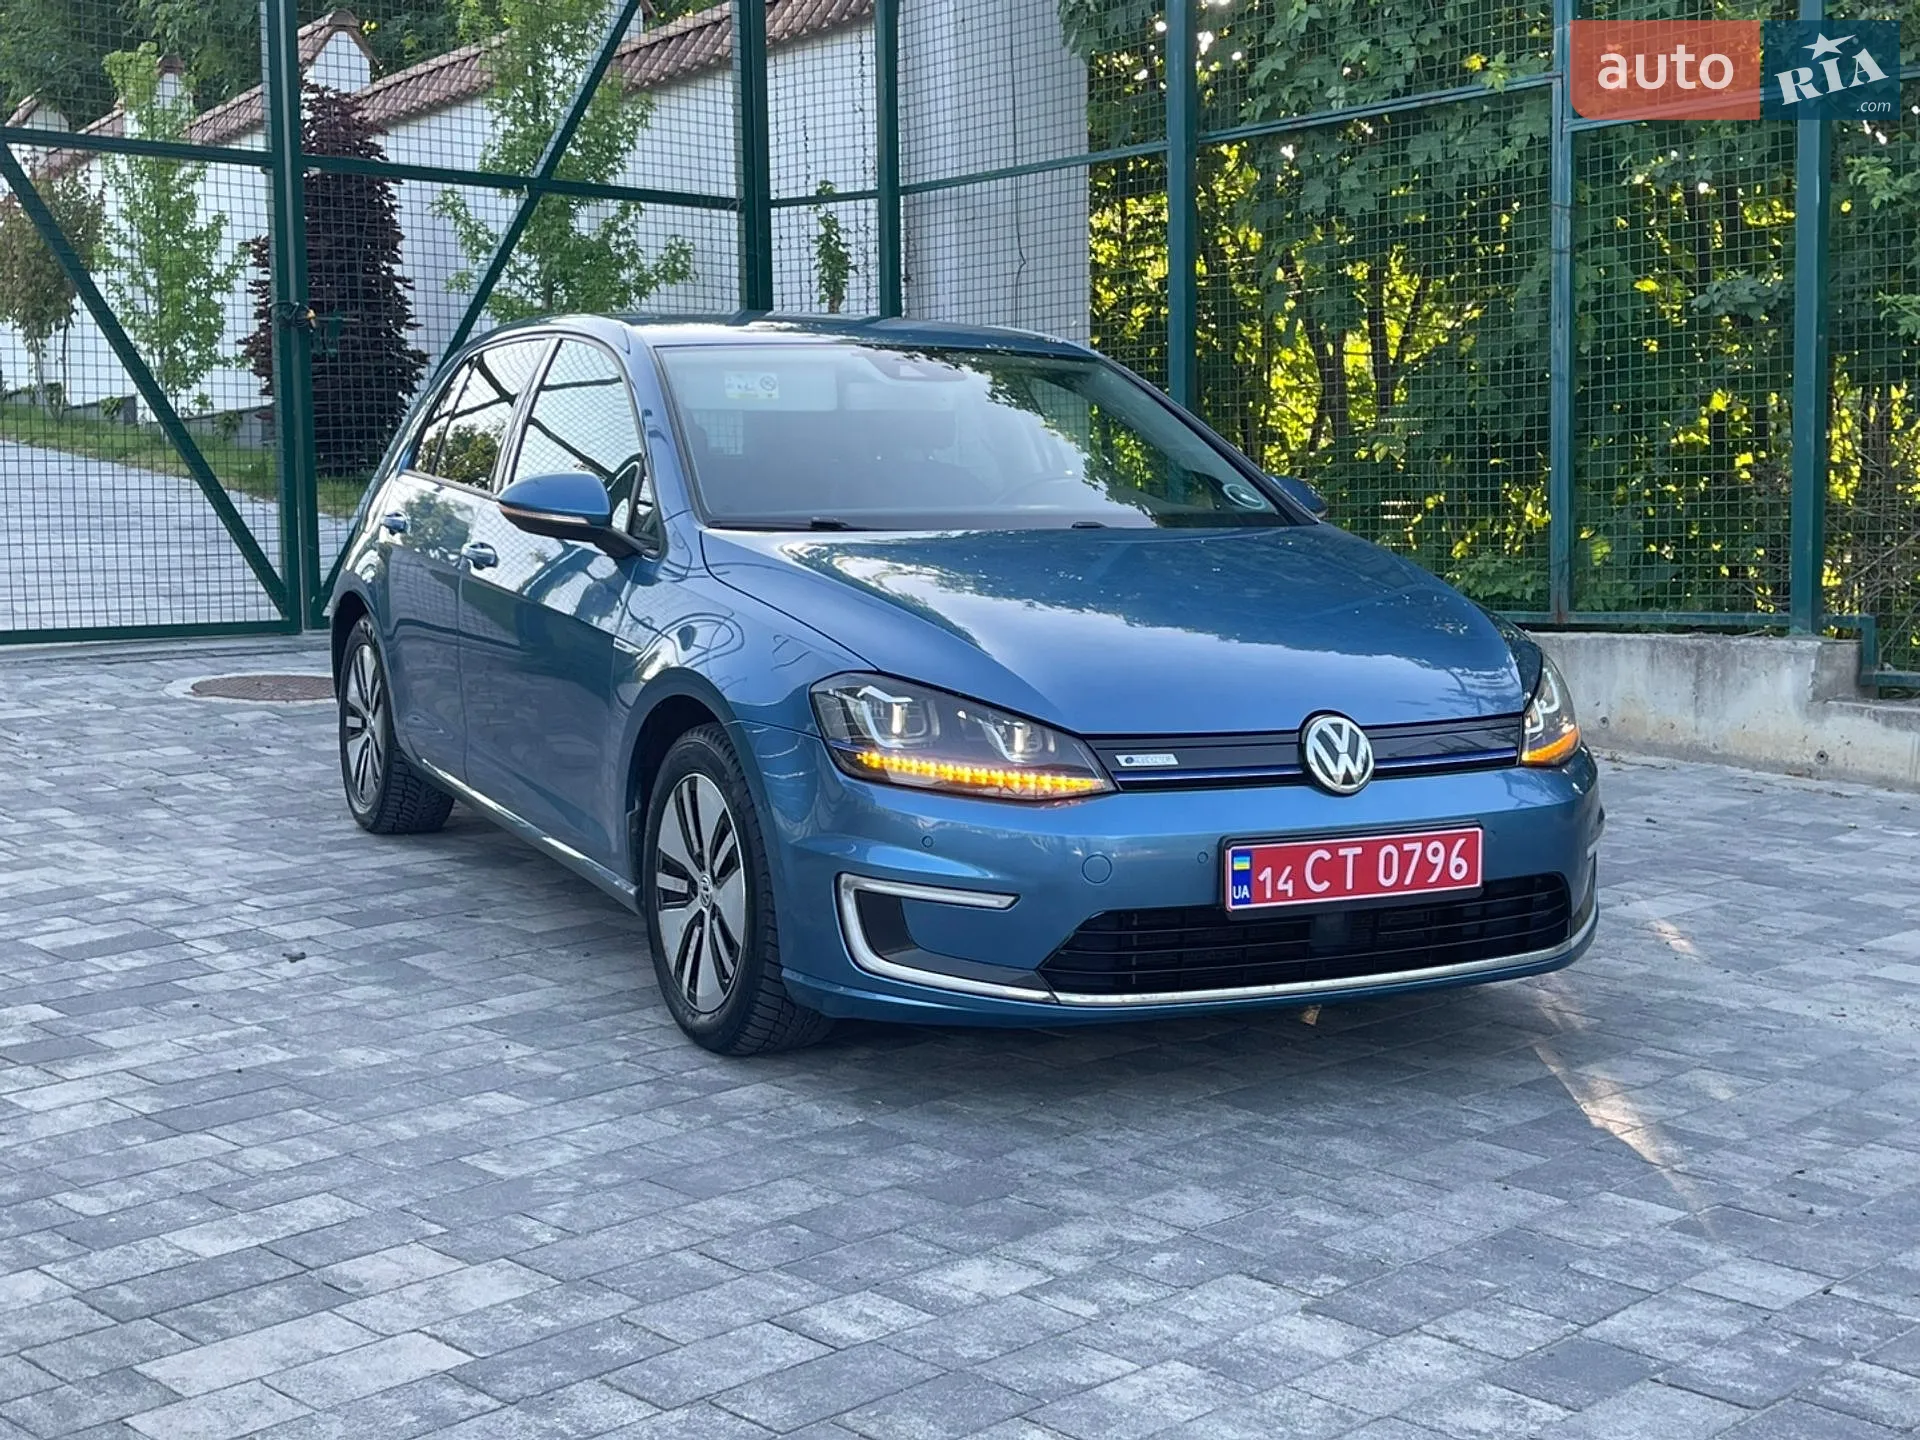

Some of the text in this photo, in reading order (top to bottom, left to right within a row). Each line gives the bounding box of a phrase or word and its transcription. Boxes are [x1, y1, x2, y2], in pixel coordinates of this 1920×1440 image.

[1258, 838, 1468, 898] 14 CT 0796
[1233, 885, 1250, 899] UA
